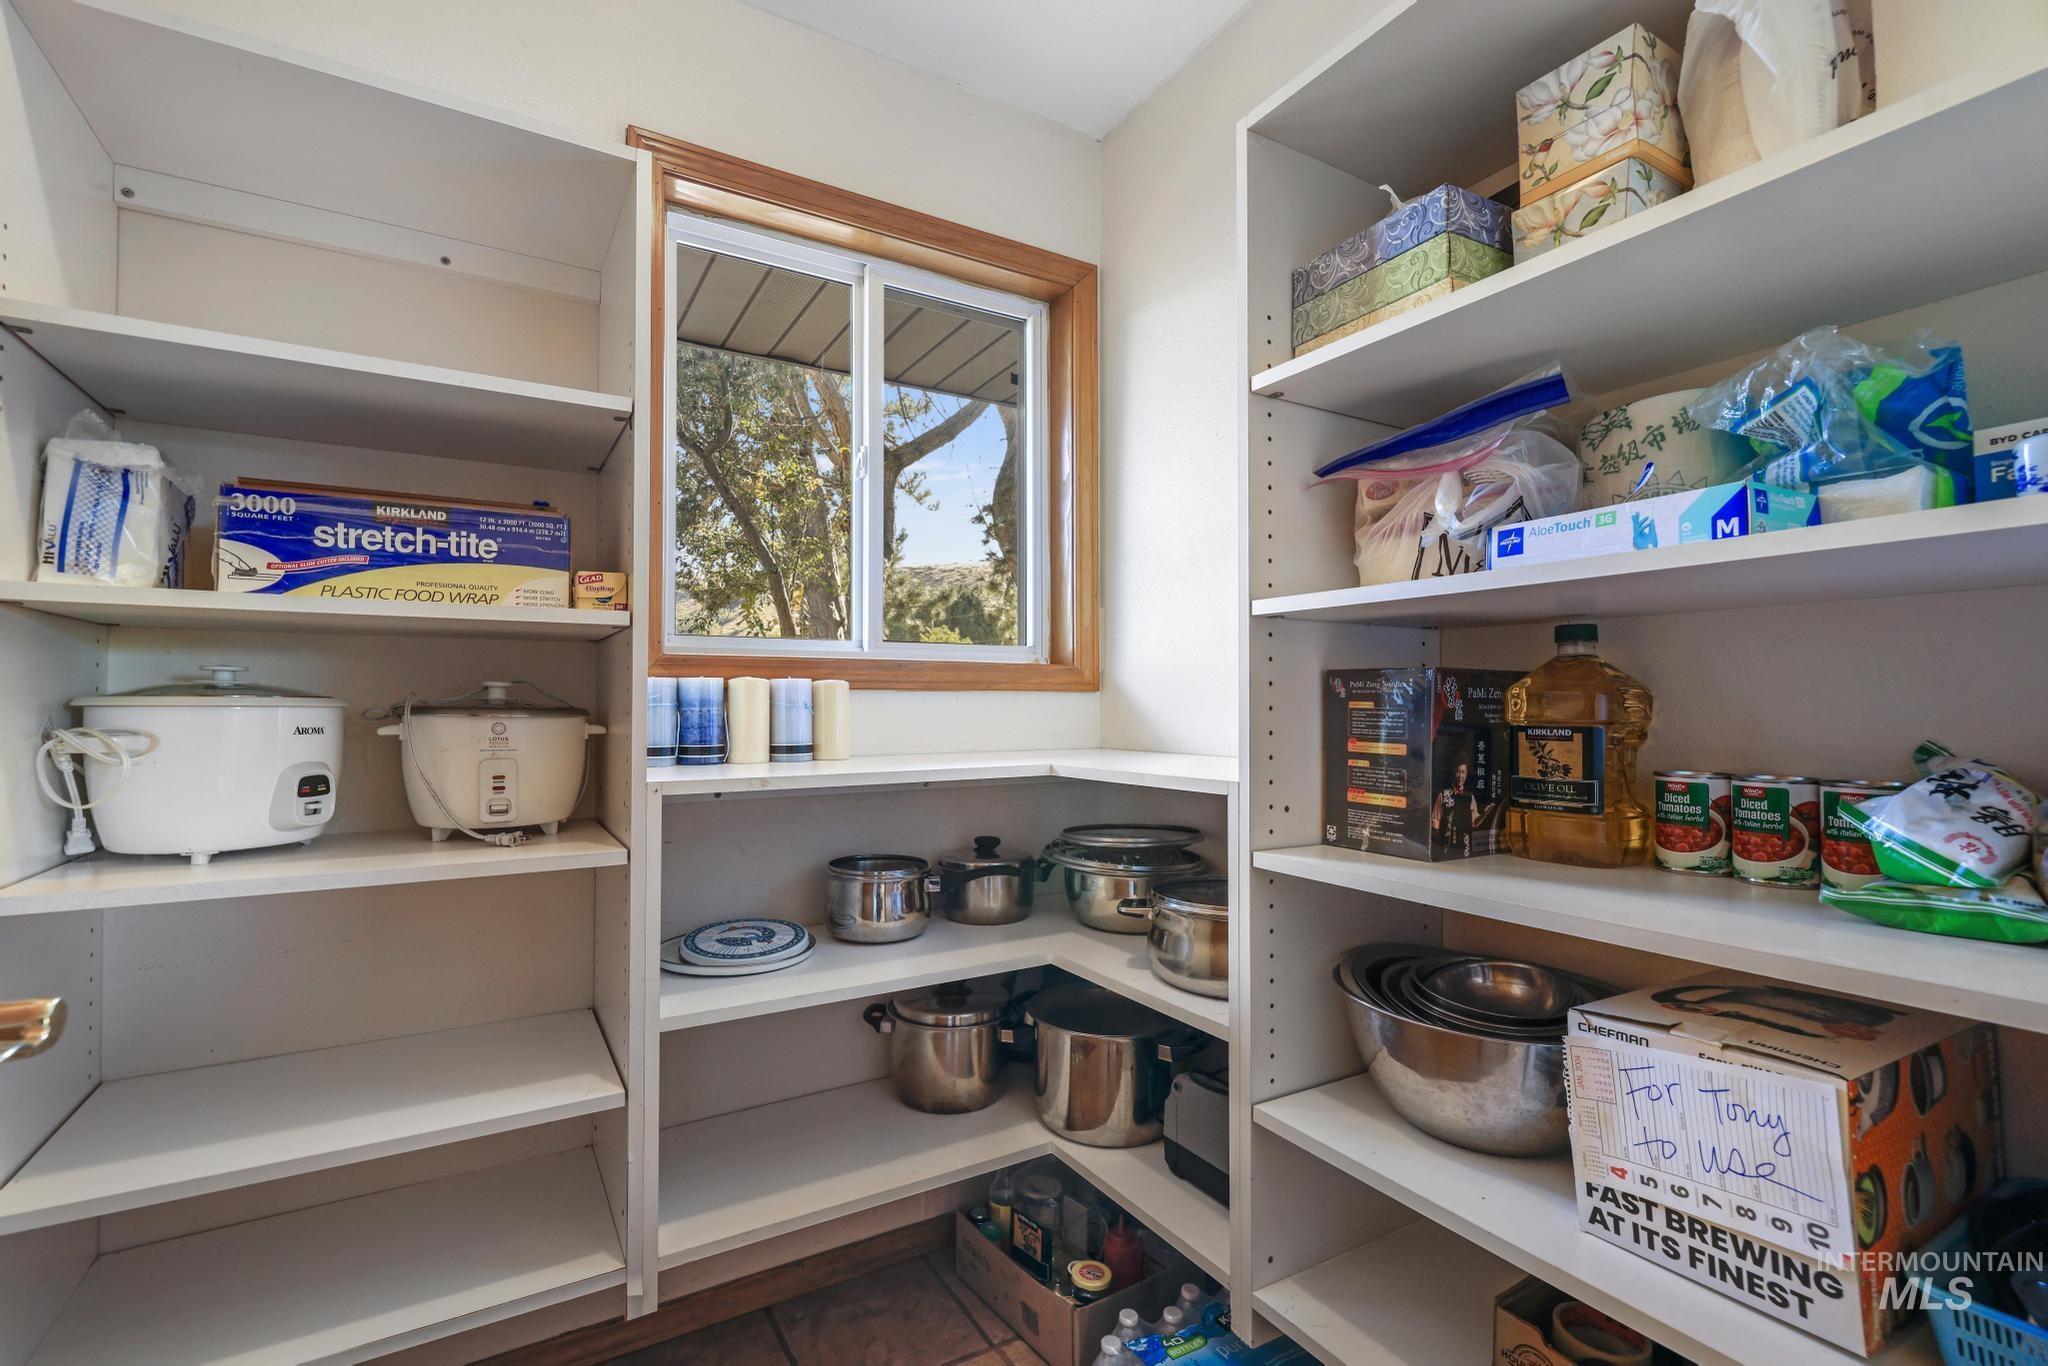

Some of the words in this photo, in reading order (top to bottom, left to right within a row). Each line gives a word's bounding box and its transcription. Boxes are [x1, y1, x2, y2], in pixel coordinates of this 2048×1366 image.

[1989, 434, 2018, 446] BYD
[229, 492, 297, 516] 3000
[231, 511, 270, 521] SQUARE
[272, 514, 294, 522] FEET
[375, 505, 447, 521] KIRKLAND
[479, 516, 487, 524] 12
[1528, 516, 1591, 538] AloeTouch
[1598, 513, 1613, 525] 3G
[1716, 517, 1740, 538] M
[312, 521, 499, 560] stretch-tite
[416, 581, 468, 590] PROFESSIONAL
[579, 574, 603, 584] GLAD
[320, 584, 392, 600] PLASTIC
[394, 588, 445, 603] FOOD
[449, 591, 500, 606] WRAP
[1488, 687, 1503, 699] Zen
[1526, 727, 1572, 738] KIRKLAND
[1524, 782, 1555, 793] OLIVE
[1556, 784, 1577, 794] OIL
[1664, 792, 1691, 804] Diced
[1740, 798, 1768, 810] Diced
[1657, 800, 1702, 815] Tomatoes
[1734, 807, 1782, 821] Tomatoes
[1762, 820, 1785, 831] herbs
[1577, 1021, 1650, 1048] CHEFMAN
[1747, 1039, 1843, 1069] CHEFMAN
[1618, 1065, 1681, 1121] For
[1698, 1088, 1792, 1157] Tony
[1633, 1125, 1677, 1167] to
[1609, 1165, 1628, 1181] 4
[1639, 1174, 1659, 1190] 5
[1670, 1183, 1690, 1199] 6
[1701, 1193, 1723, 1210] 7
[1735, 1204, 1757, 1222] 8
[1770, 1216, 1793, 1234] 9
[1585, 1181, 1659, 1223] FAST
[1664, 1206, 1844, 1300] BREWING
[1806, 1222, 1831, 1251] 10
[1588, 1205, 1626, 1237] AT
[1631, 1221, 1681, 1261] ITS
[1687, 1244, 1815, 1320] FINEST
[1162, 1336, 1185, 1348] 40
[1169, 1336, 1205, 1356] BOTTLES
